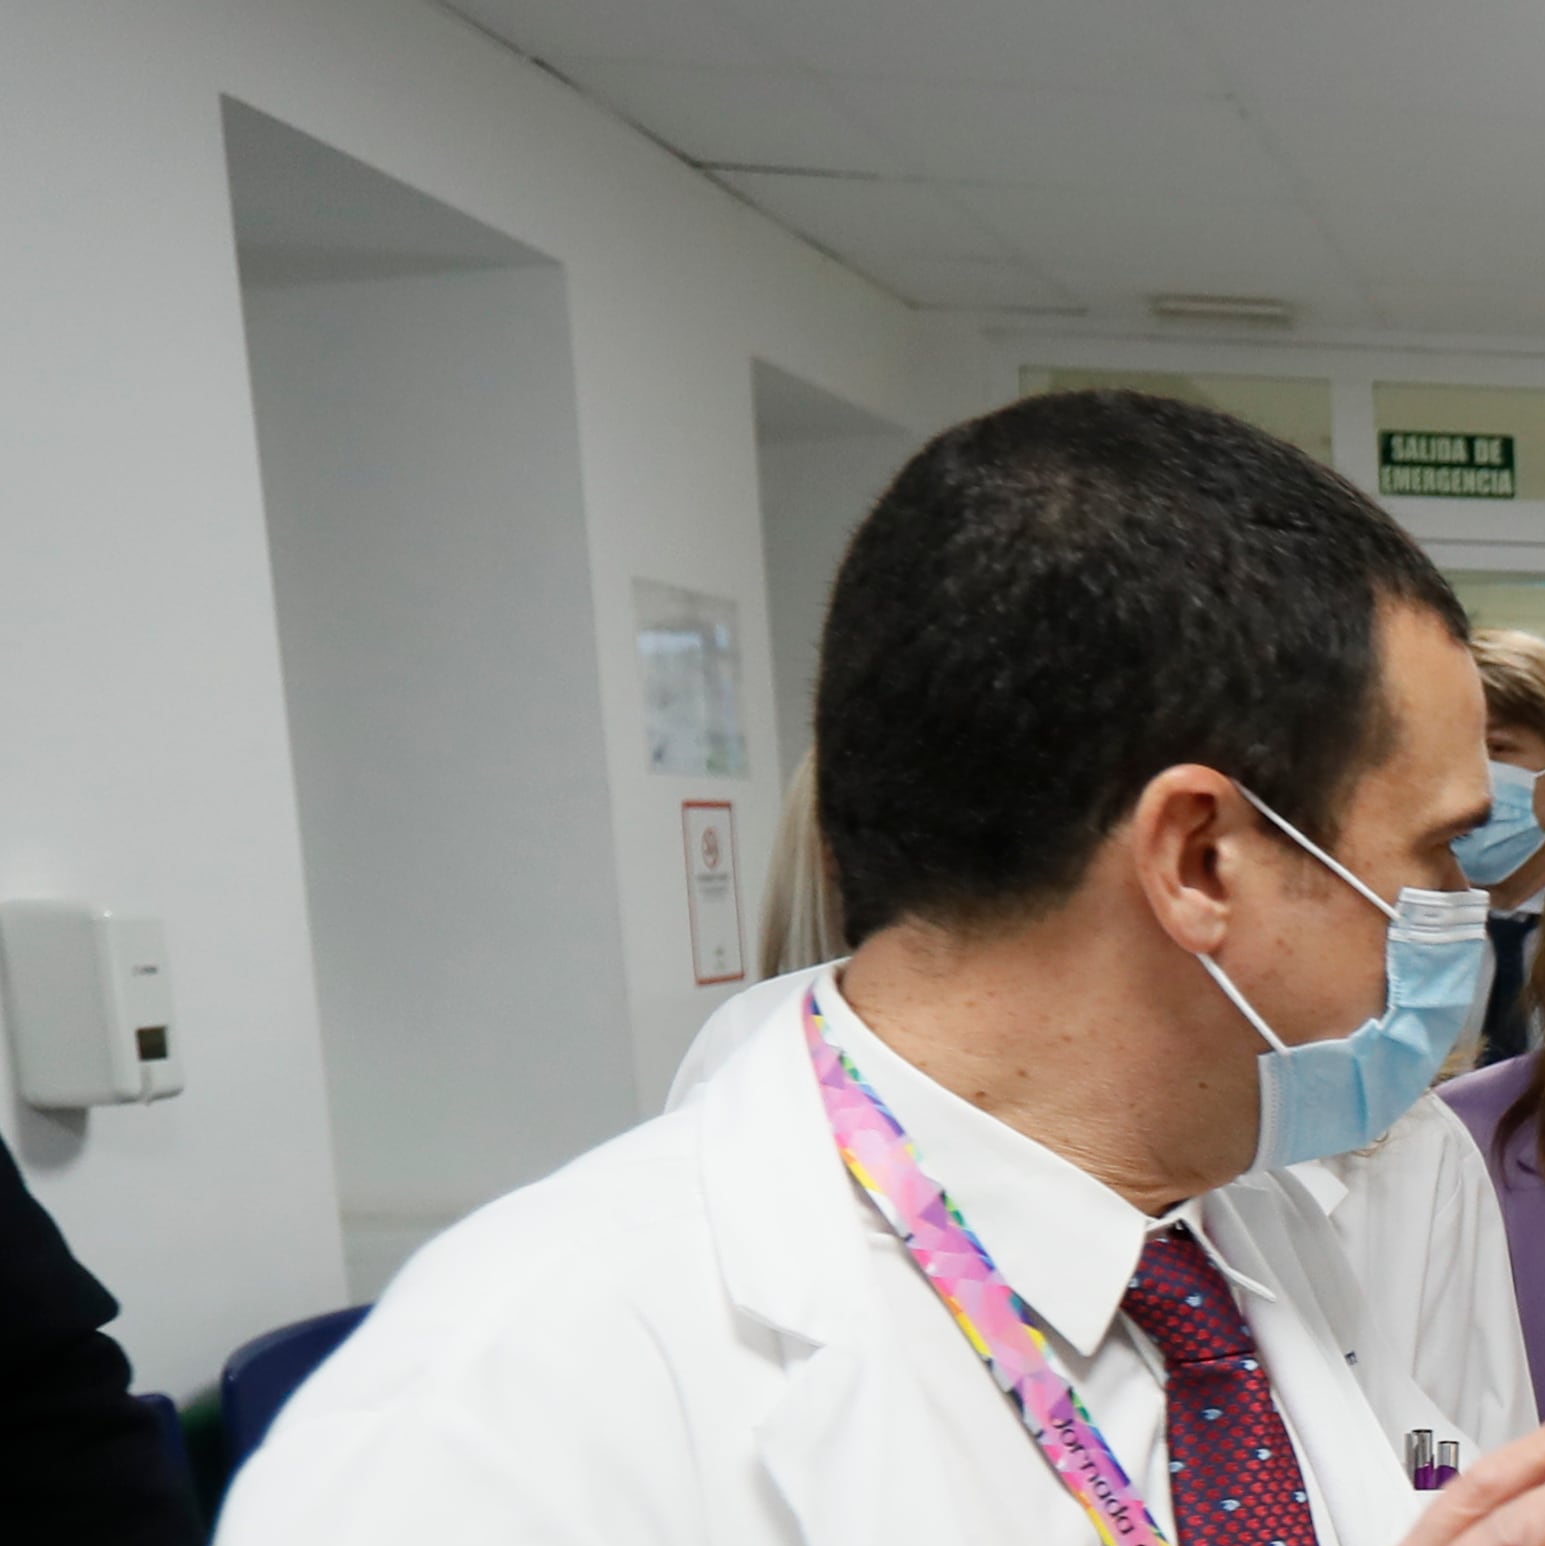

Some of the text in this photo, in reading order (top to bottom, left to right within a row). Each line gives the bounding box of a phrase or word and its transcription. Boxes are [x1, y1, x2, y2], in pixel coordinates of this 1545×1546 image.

[1390, 434, 1504, 465] SALIDA DE
[1380, 464, 1513, 494] EMERGENCIA
[1053, 1418, 1135, 1536] Jornada
